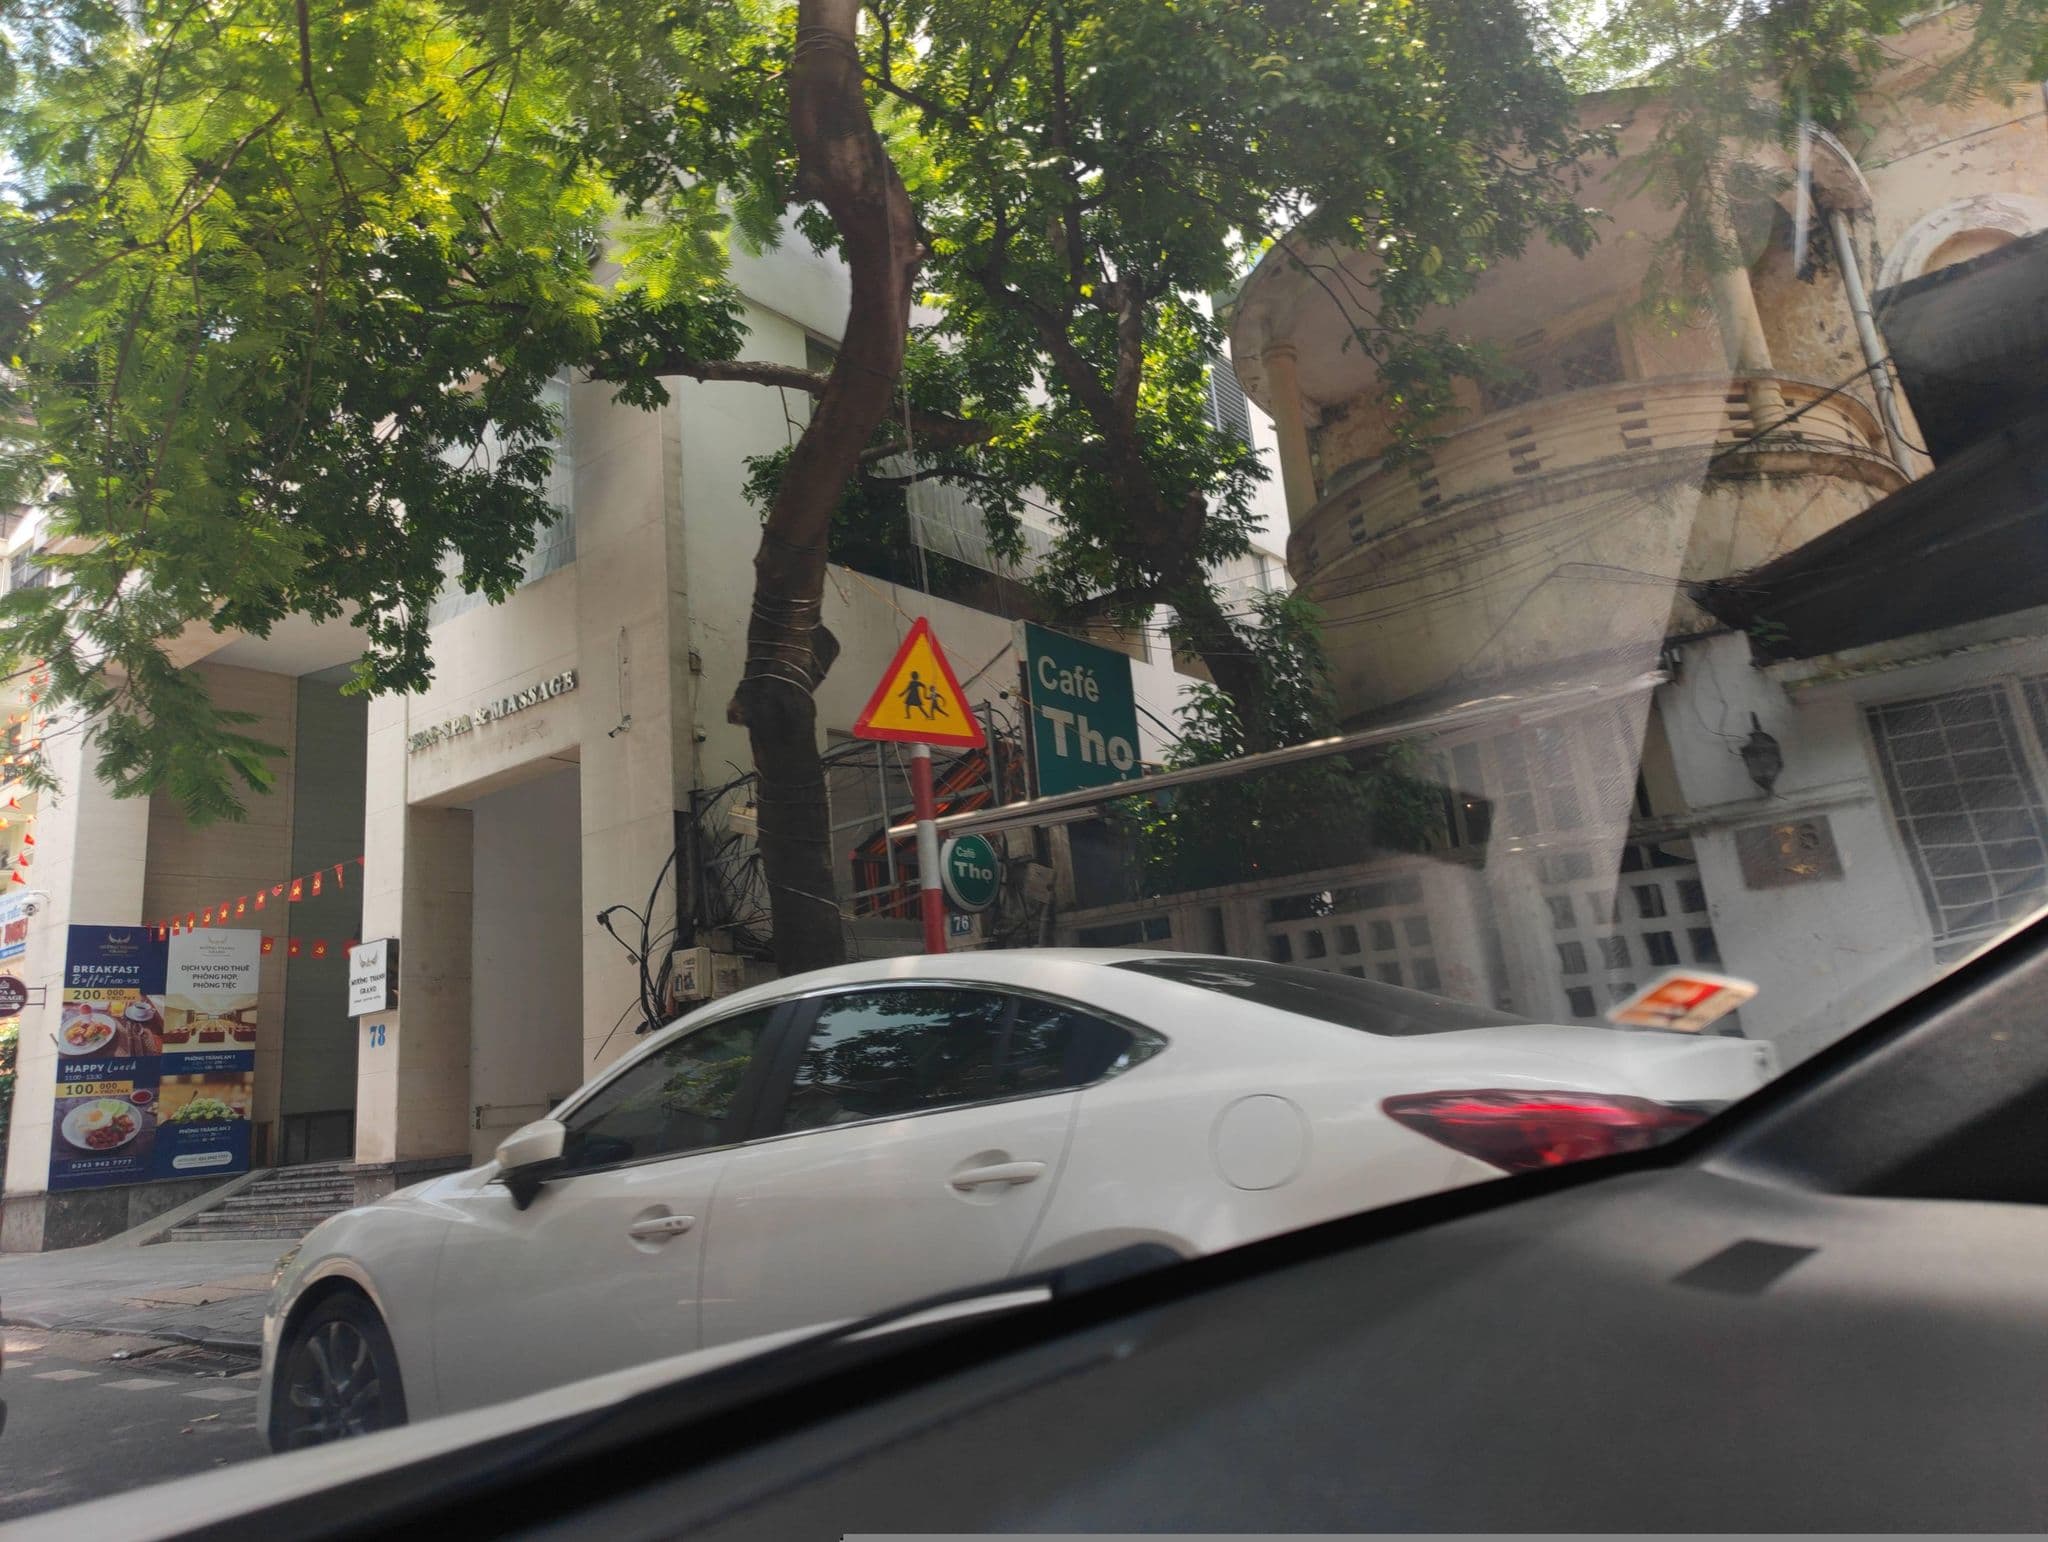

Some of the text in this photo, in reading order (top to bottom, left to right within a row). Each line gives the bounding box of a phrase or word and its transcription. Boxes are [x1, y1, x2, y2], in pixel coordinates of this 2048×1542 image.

[1038, 655, 1100, 702] Café
[474, 707, 491, 727] &
[490, 669, 577, 722] MASSAGE
[1041, 704, 1135, 780] Thọ
[954, 861, 993, 884] Thọ
[953, 915, 970, 932] 76
[73, 965, 140, 974] BREAKFAST
[181, 964, 200, 972] DỊCH
[230, 964, 250, 972] THUÊ
[192, 972, 220, 980] PHÒNG
[192, 981, 238, 989] PHÒNG TIỆC
[369, 1024, 385, 1048] 78
[65, 1060, 137, 1073] HAPPY Lunch
